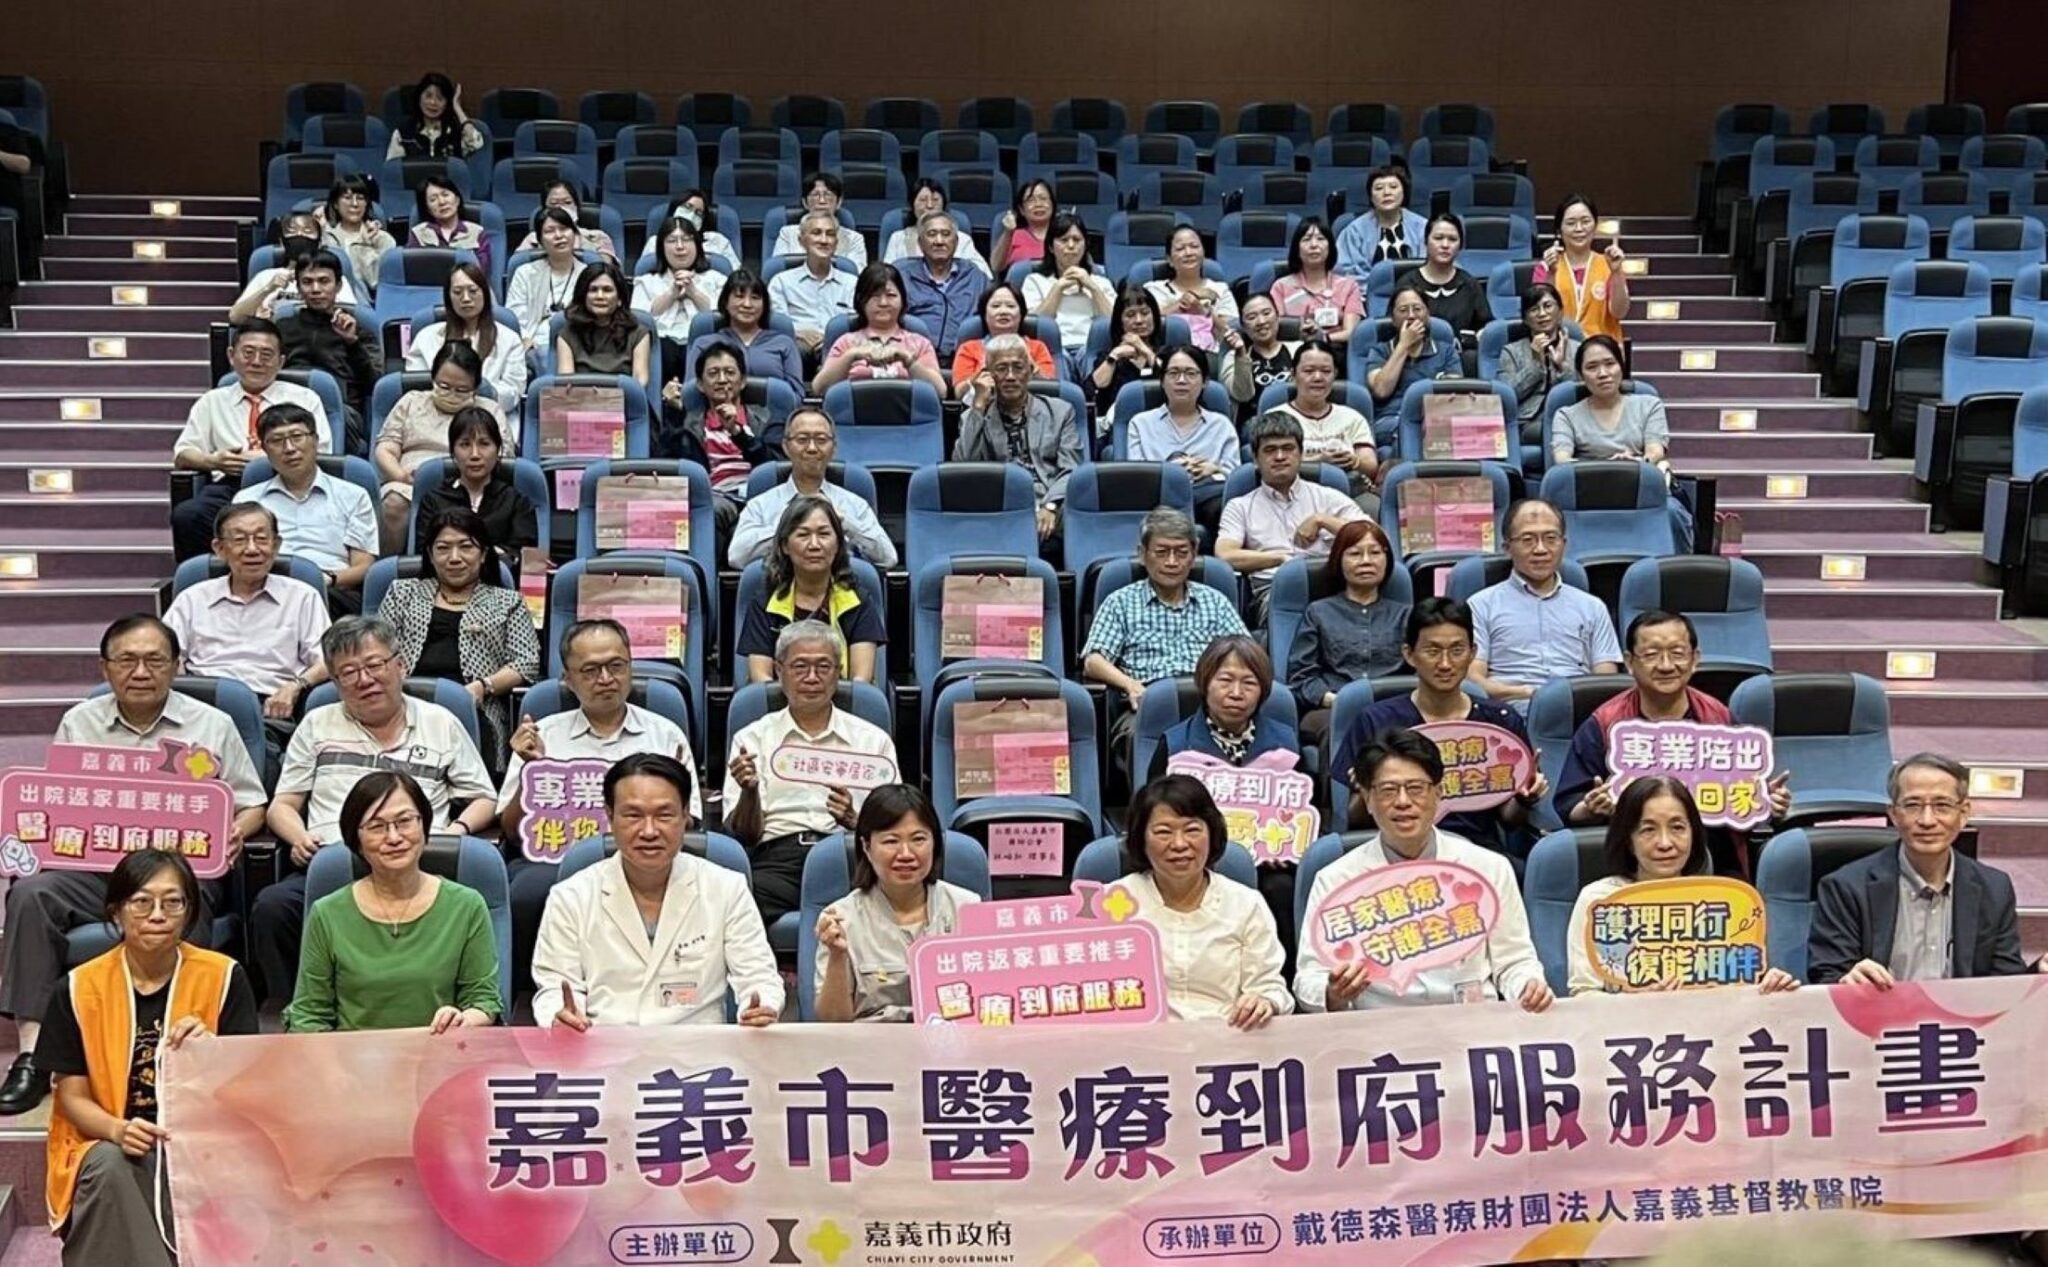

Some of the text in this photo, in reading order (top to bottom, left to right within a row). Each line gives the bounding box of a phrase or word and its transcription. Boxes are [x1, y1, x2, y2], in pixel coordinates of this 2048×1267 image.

[81, 752, 152, 773] 嘉義市
[1621, 732, 1763, 771] 專業陪出
[20, 784, 211, 813] 出院返家重要推手
[1174, 767, 1304, 807] 療到府
[16, 811, 210, 858] 醫療到府服務
[996, 903, 1069, 929] 嘉義市
[1321, 875, 1444, 942] 居家醫療
[1593, 901, 1731, 944] 護理同行
[1361, 902, 1487, 966] 守護全嘉
[936, 938, 1137, 975] 出院返家重要推手
[1625, 944, 1764, 986] 復能相伴
[935, 976, 1145, 1025] 醫療到府服務
[486, 1023, 1988, 1190] 嘉義市醫療到府服務計畫
[1293, 1175, 1884, 1247] 戴德森醫療財團法人嘉義基督教醫院
[626, 1230, 736, 1257] 主辦單位
[864, 1220, 1013, 1248] 嘉義市政府
[1158, 1221, 1266, 1250] 承辦單位
[867, 1254, 1015, 1264] CHIAYI CITY GOVERNMENT
